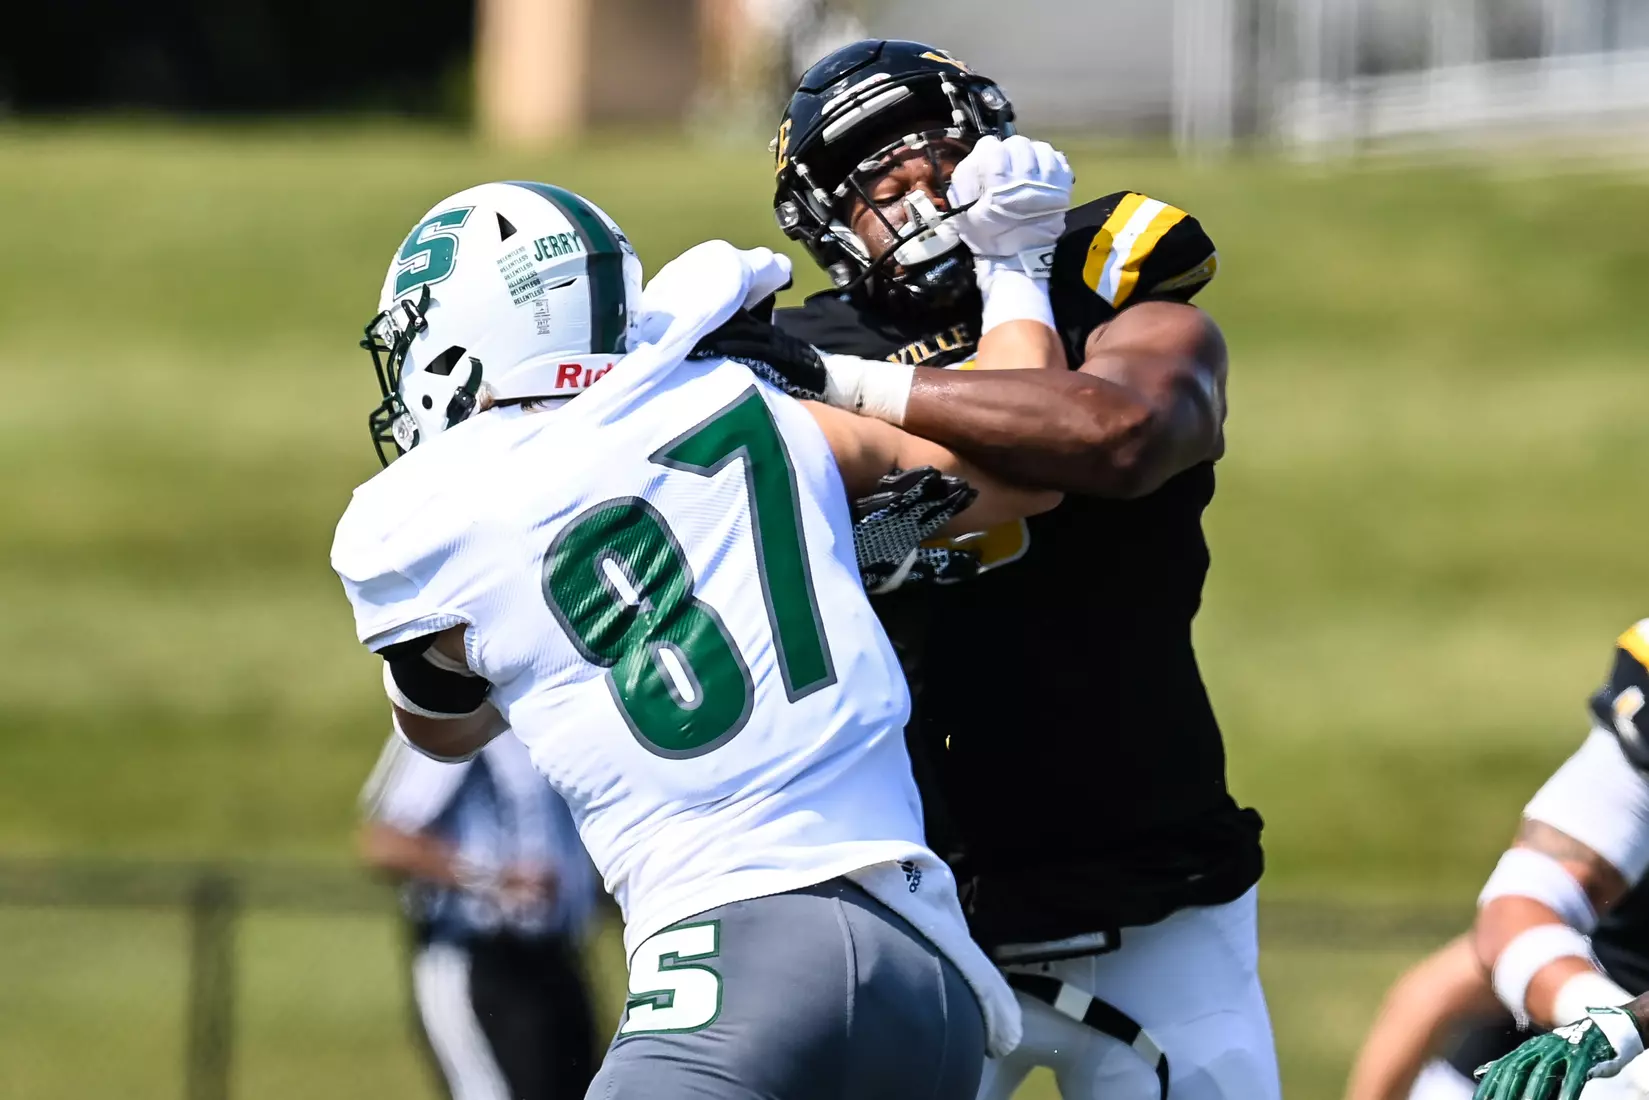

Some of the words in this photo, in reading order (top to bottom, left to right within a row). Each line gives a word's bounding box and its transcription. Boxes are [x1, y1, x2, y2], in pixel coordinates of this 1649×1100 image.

[393, 206, 476, 303] S
[496, 246, 526, 265] RELENTLESS
[534, 231, 581, 262] JERRY
[500, 254, 529, 273] RELENTLESS
[504, 262, 533, 281] RELENTLESS
[508, 270, 538, 289] RELENTLESS
[510, 278, 542, 297] RELENTLESS
[514, 287, 545, 306] RELENTLESS
[541, 384, 838, 760] 87
[617, 919, 723, 1040] S
